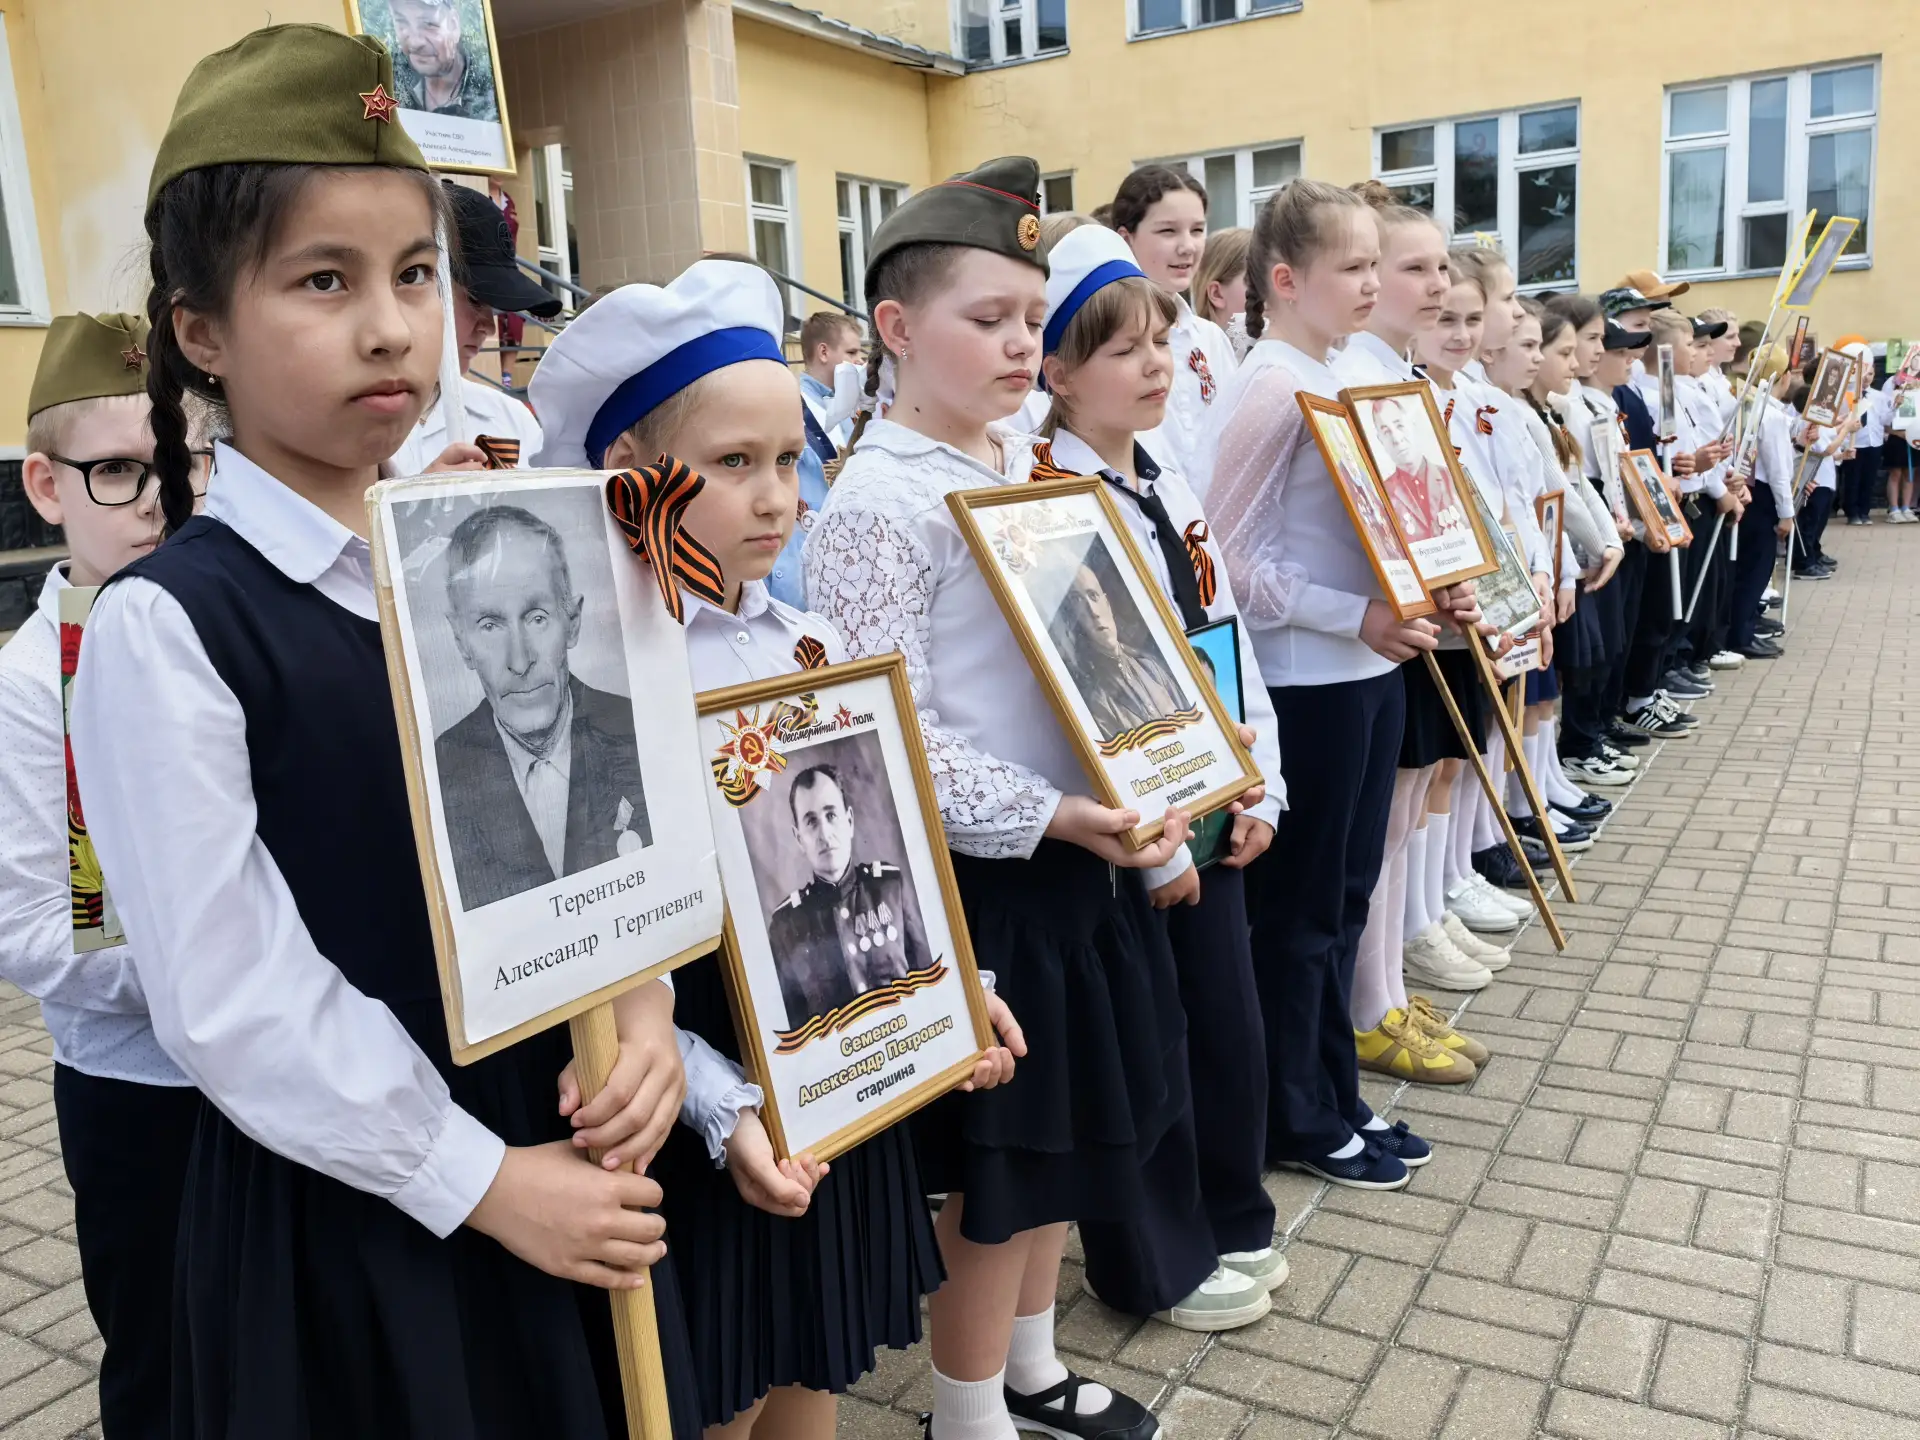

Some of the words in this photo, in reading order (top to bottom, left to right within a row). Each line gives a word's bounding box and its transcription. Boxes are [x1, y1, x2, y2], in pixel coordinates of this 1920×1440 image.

[1130, 774, 1164, 797] Иван
[1159, 752, 1216, 784] Ефимович
[1144, 741, 1184, 765] Титков
[1166, 779, 1206, 805] разведчик
[549, 870, 646, 918] Терентьев
[493, 933, 599, 991] Александр
[613, 889, 704, 939] Гергиевич
[840, 1014, 907, 1056] Семенов
[799, 1051, 886, 1108] Александр
[885, 1014, 954, 1062] Петрович
[855, 1061, 917, 1104] старшина
